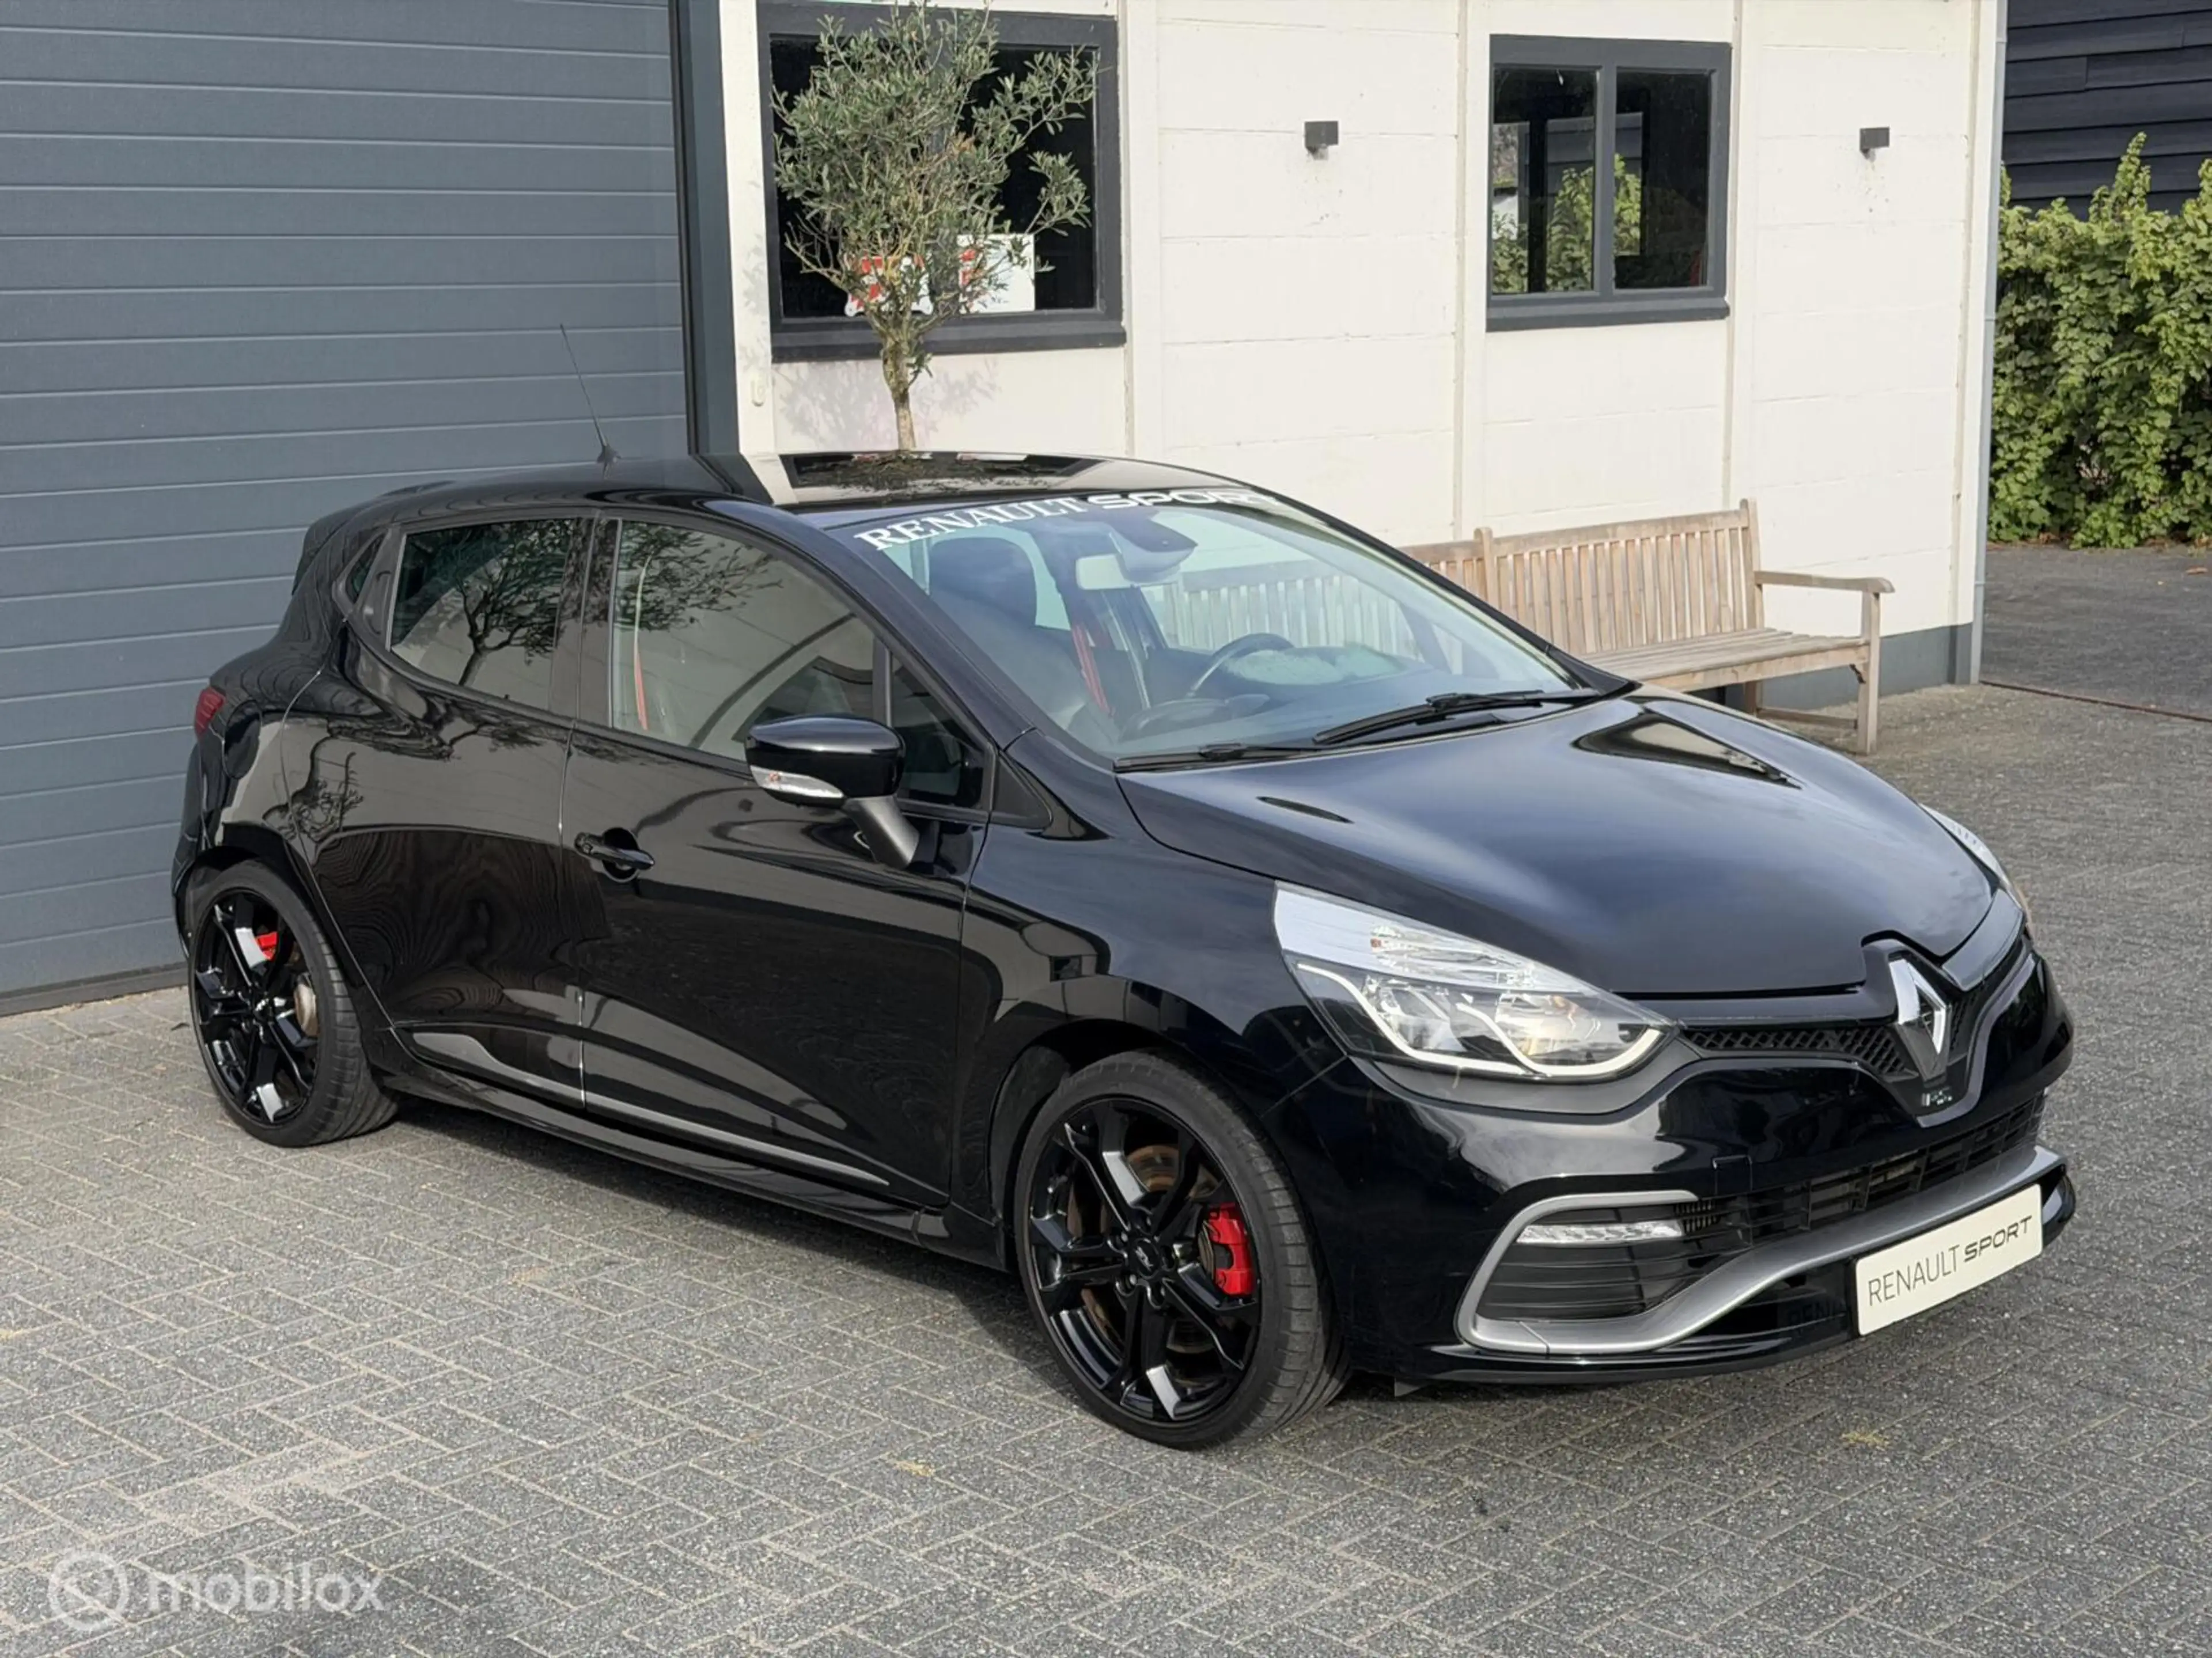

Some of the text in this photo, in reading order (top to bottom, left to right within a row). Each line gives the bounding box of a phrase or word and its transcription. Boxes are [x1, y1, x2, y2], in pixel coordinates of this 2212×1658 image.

[854, 497, 1086, 551] RENAULT
[1868, 1215, 2032, 1306] RENAULT SPORT
